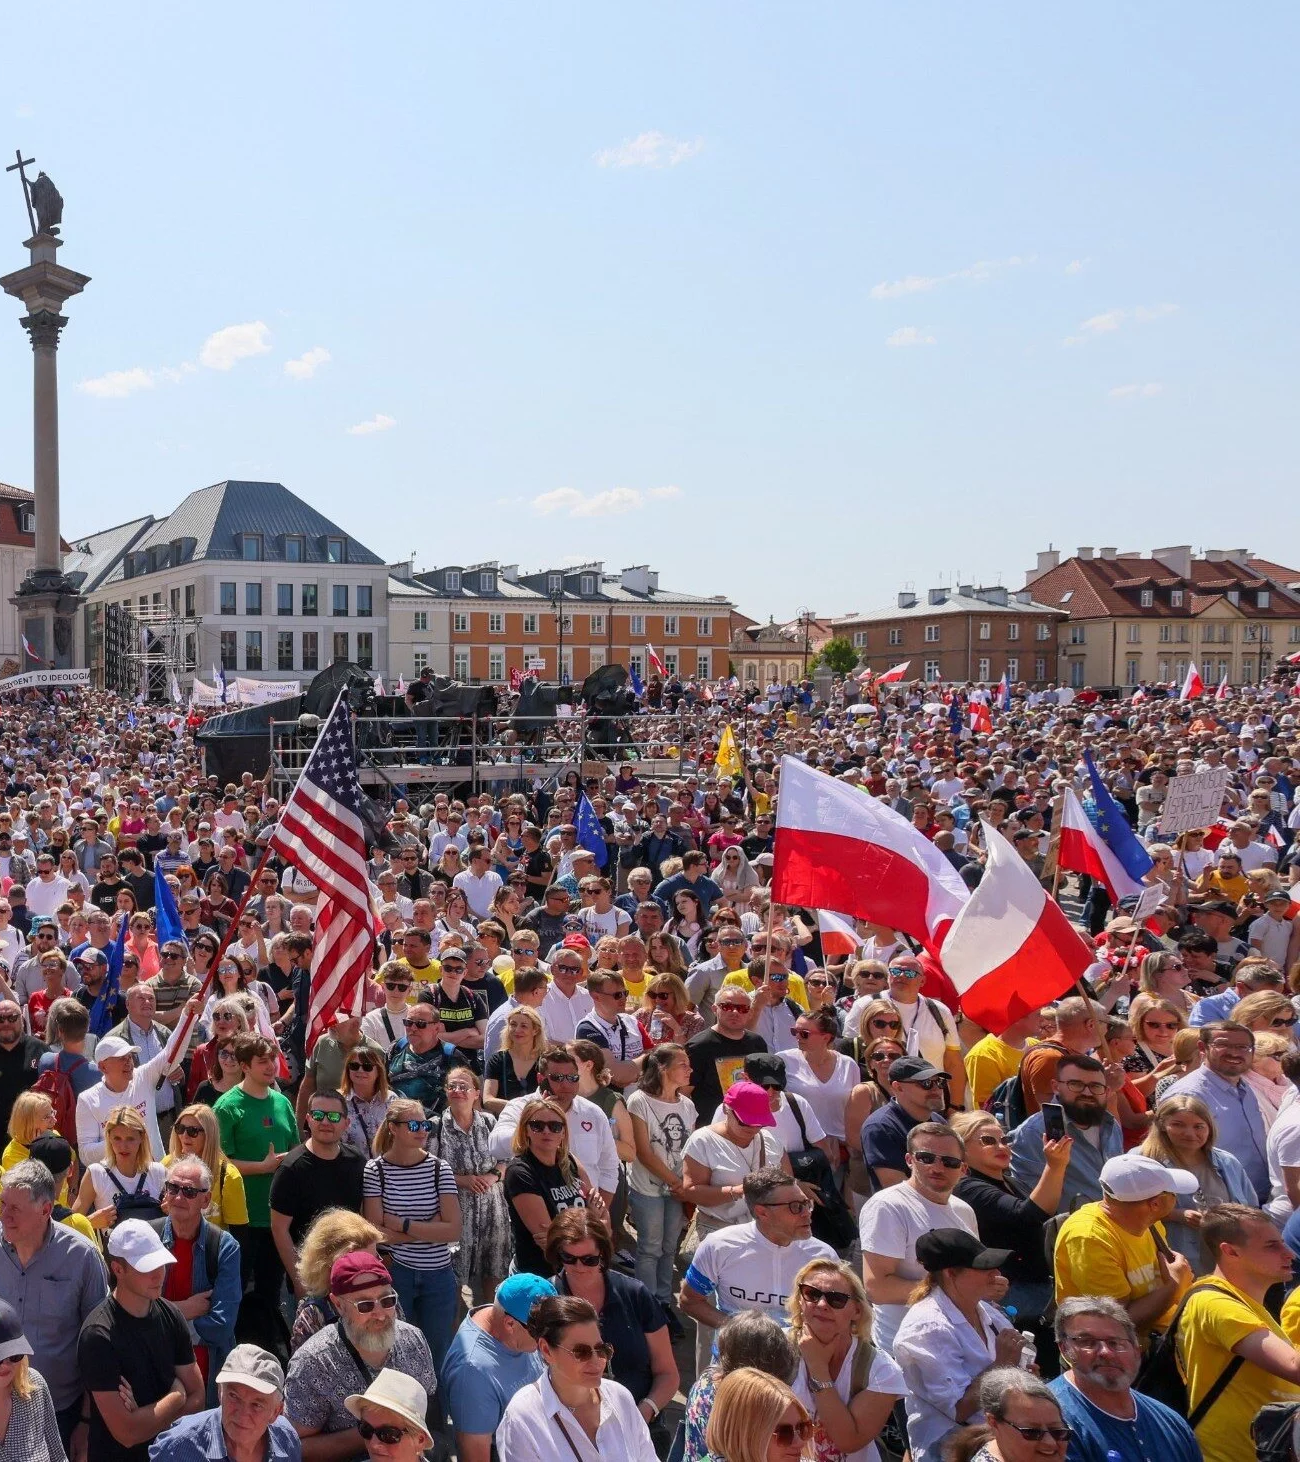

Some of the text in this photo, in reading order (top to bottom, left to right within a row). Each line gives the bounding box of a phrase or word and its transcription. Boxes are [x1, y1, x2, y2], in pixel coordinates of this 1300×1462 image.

[36, 674, 48, 682] TO
[49, 672, 90, 682] IDEOLOGIA
[440, 1010, 473, 1020] GAME OVER
